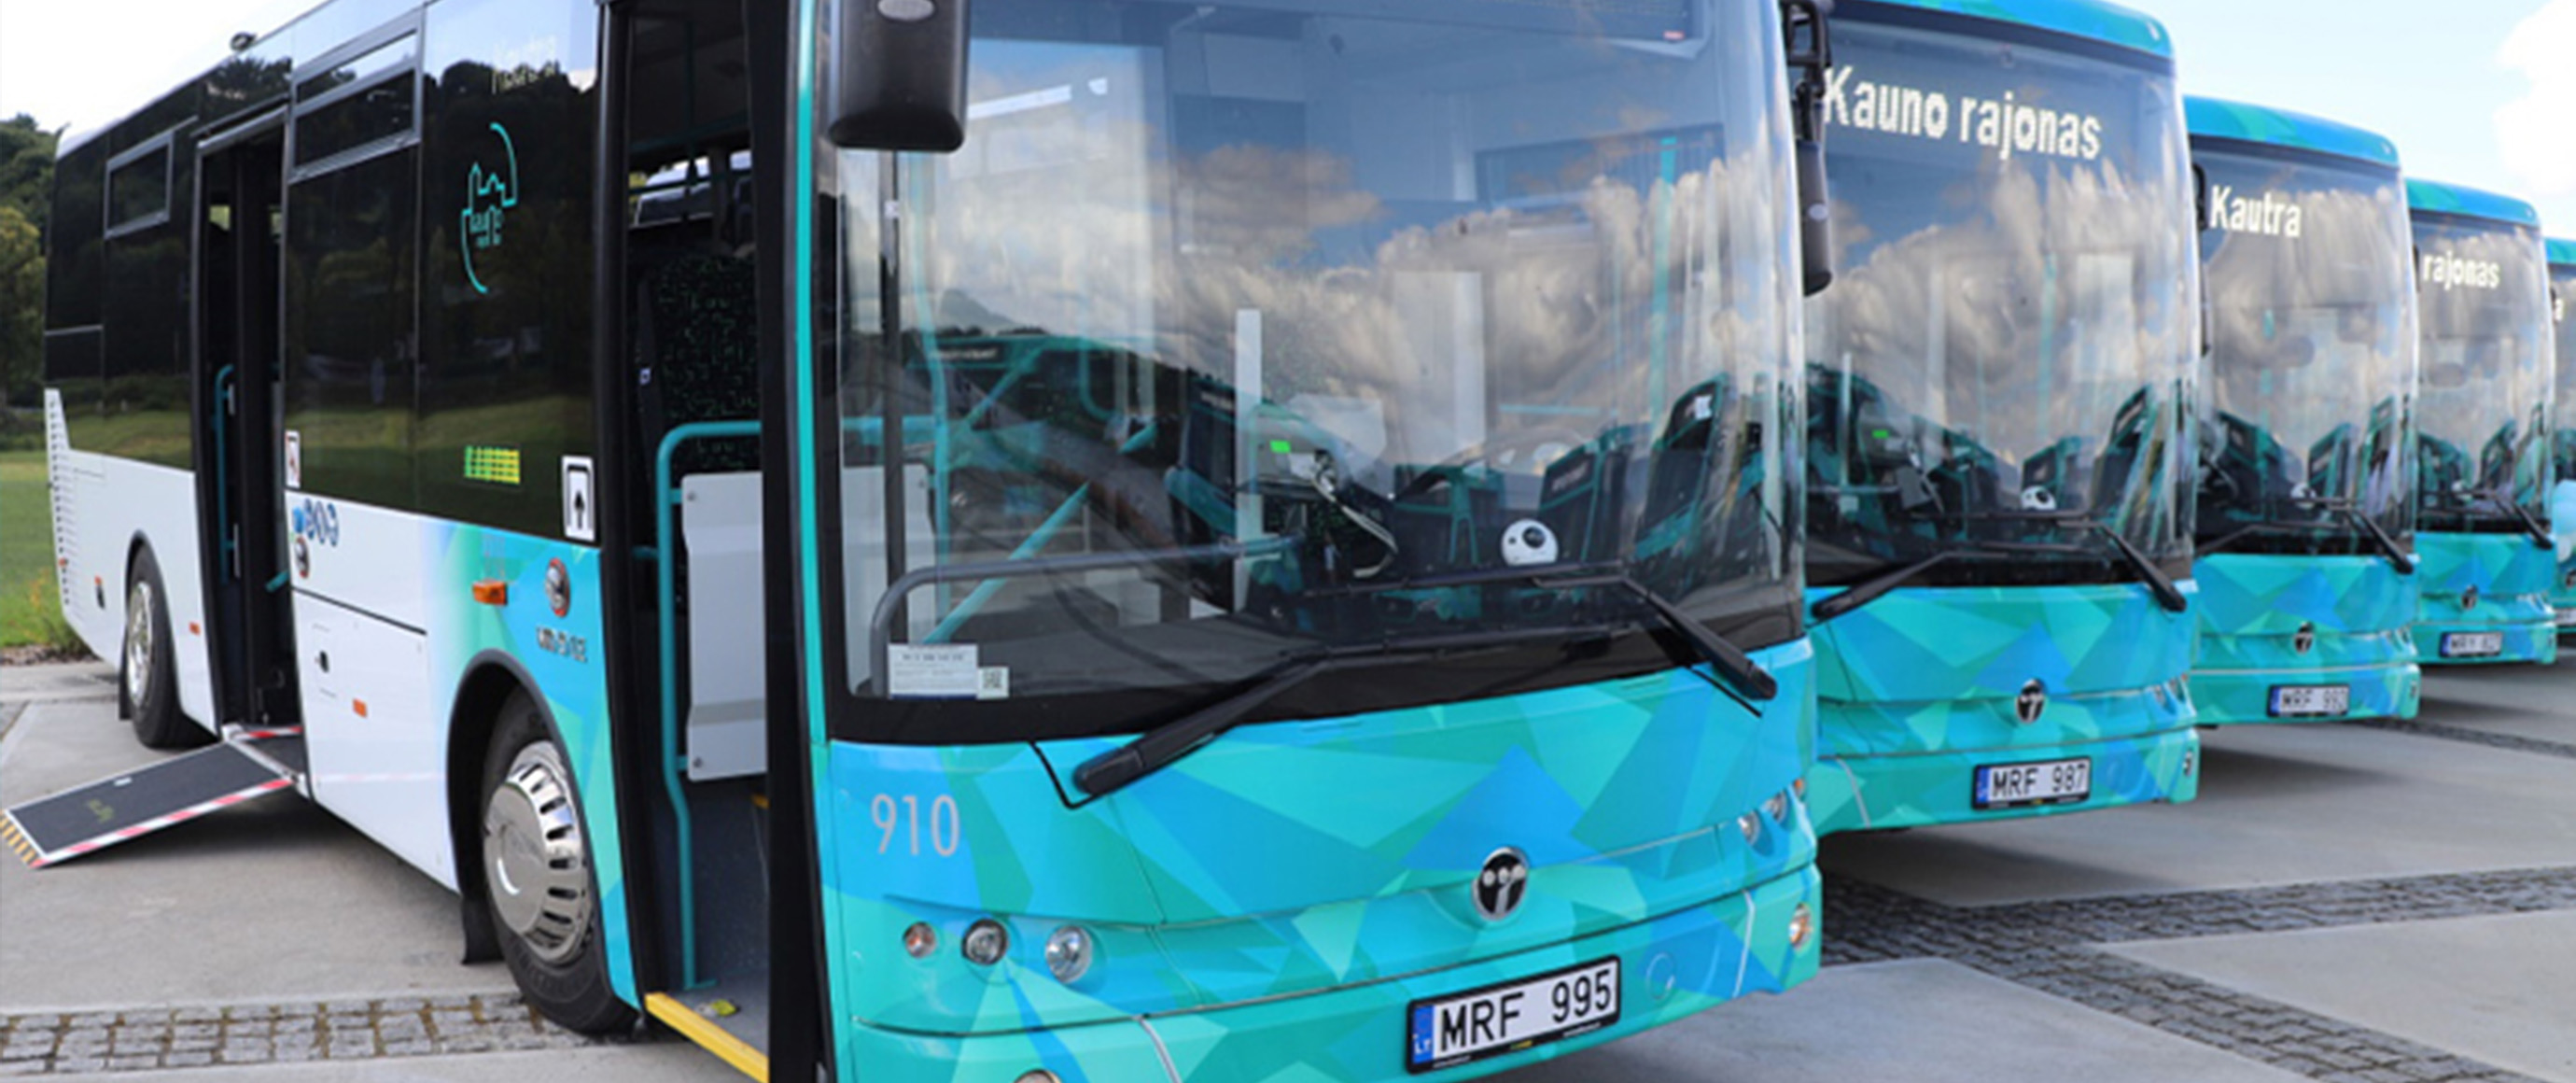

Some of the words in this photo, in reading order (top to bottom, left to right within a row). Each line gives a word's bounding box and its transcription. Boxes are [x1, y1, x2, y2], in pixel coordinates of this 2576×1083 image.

[1823, 64, 1949, 139] Kauno
[1960, 91, 2102, 161] rajonas
[2209, 185, 2302, 237] Kautra
[2423, 250, 2499, 290] rajonas
[1993, 767, 2038, 797] MRF
[2052, 763, 2087, 792] 987
[872, 794, 960, 856] 910
[1441, 992, 1524, 1052] MRF
[1552, 968, 1612, 1023] 995
